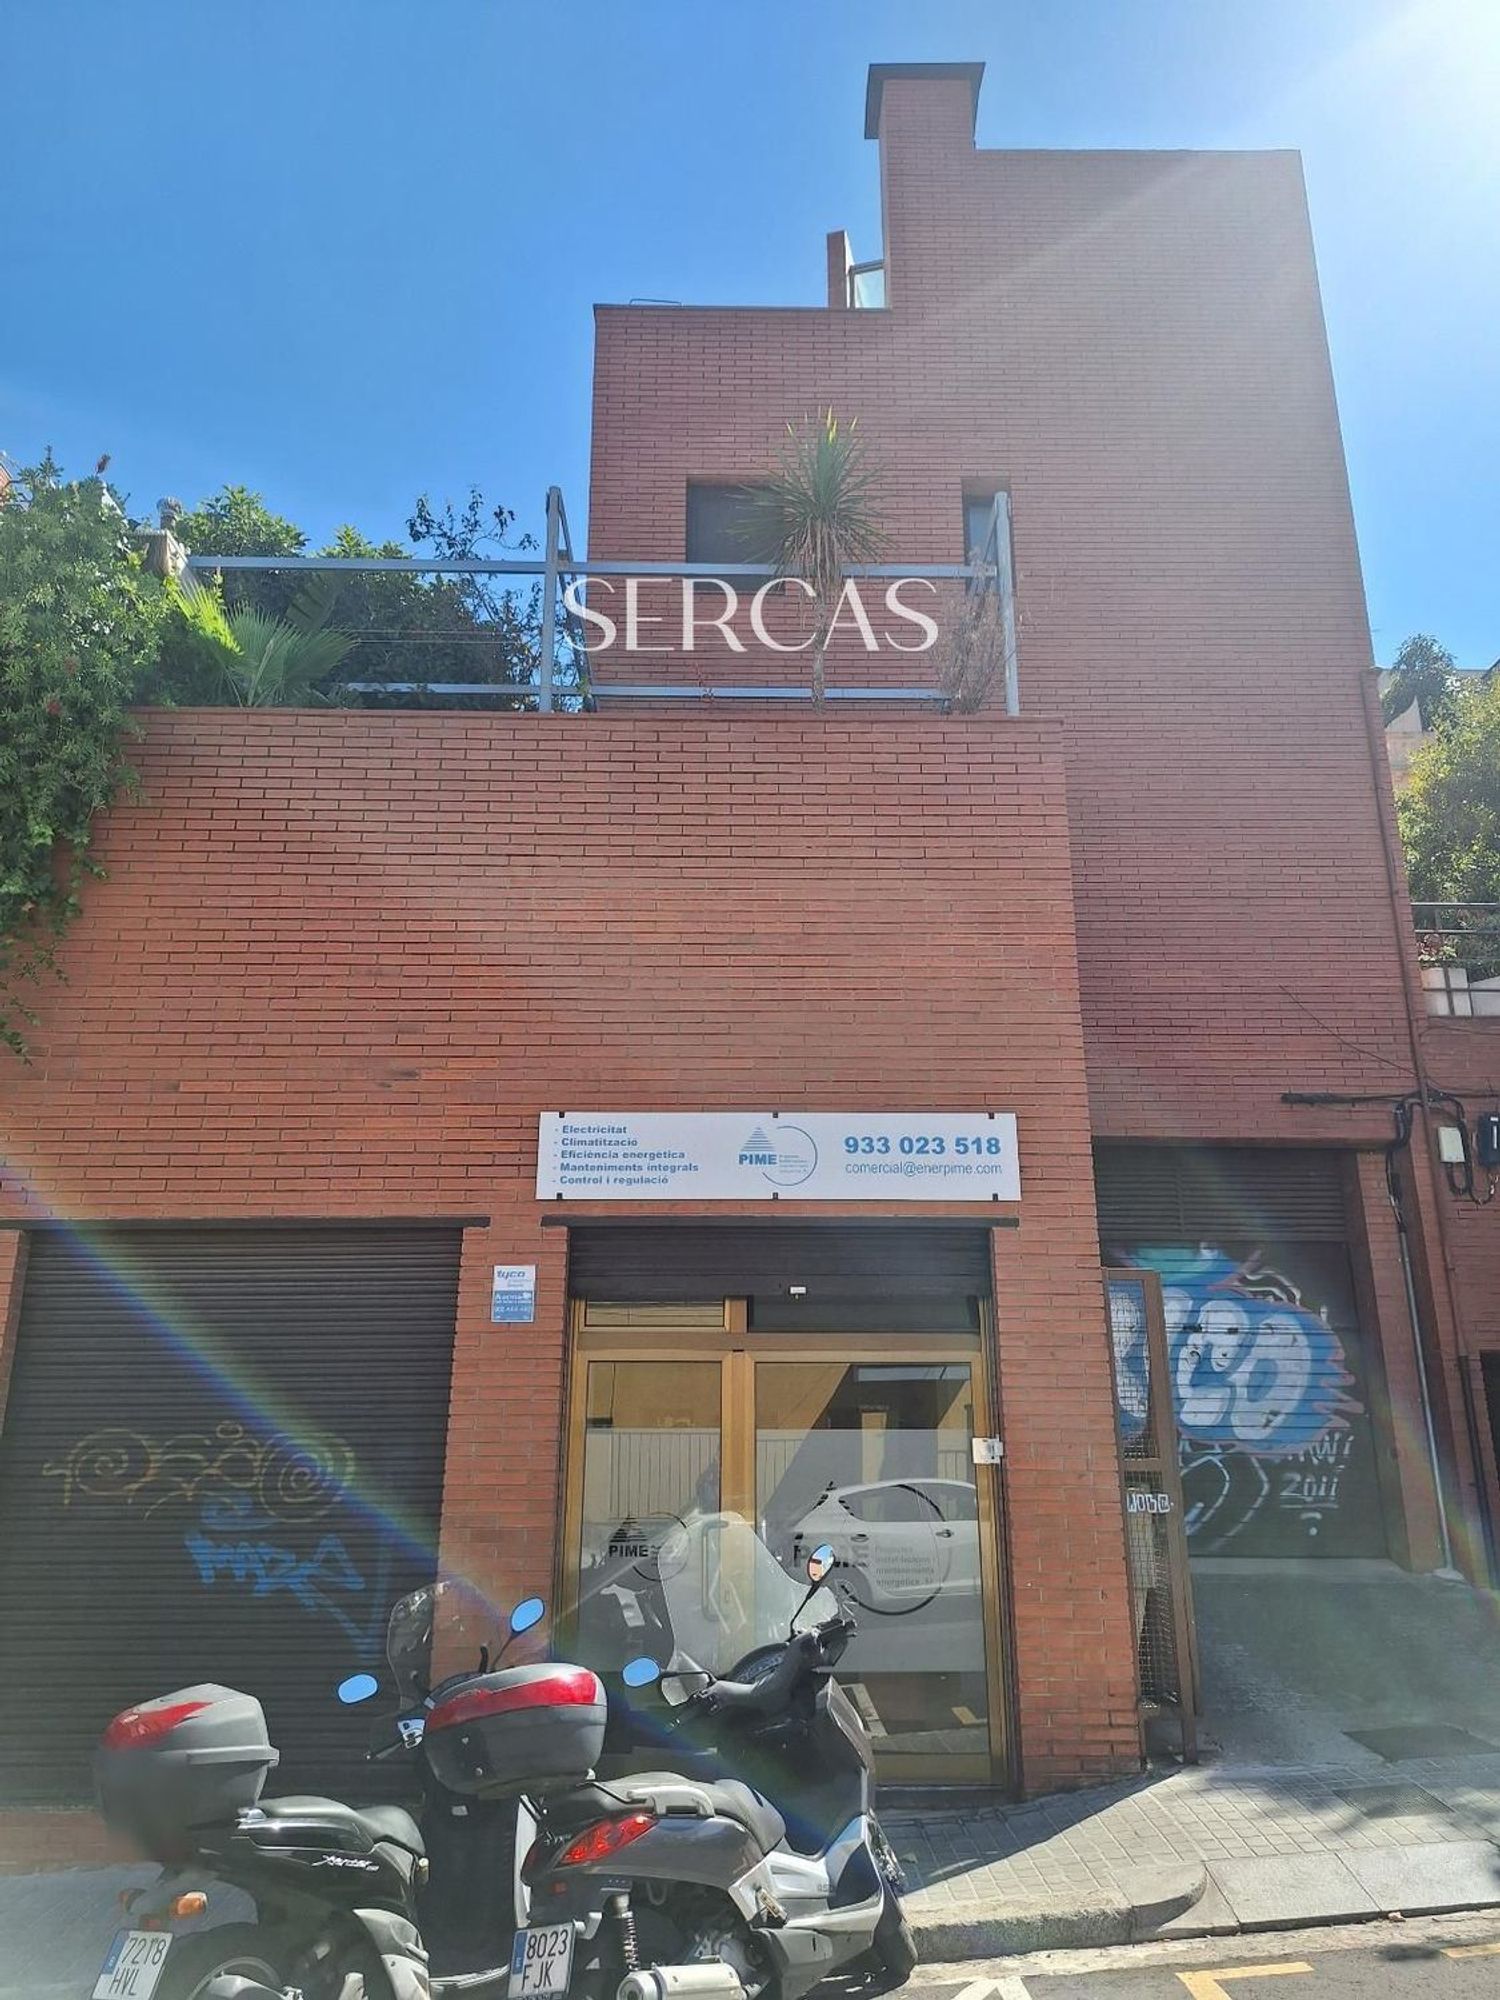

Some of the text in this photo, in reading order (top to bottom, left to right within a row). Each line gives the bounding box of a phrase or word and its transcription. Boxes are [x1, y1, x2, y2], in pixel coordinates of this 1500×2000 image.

[562, 1125, 627, 1134] Electricitat
[844, 1136, 1001, 1155] 933 023 518
[738, 1154, 777, 1165] PIME
[560, 1163, 699, 1174] Manteniments integrals
[845, 1161, 1003, 1177] comercial@enerpime.com
[559, 1175, 603, 1184] Control
[613, 1174, 669, 1186] regulació
[497, 1270, 525, 1280] tyco
[608, 1544, 649, 1558] PIME
[526, 1929, 568, 1960] 8023
[108, 1966, 140, 1996] HVL
[521, 1960, 554, 1991] FJK
